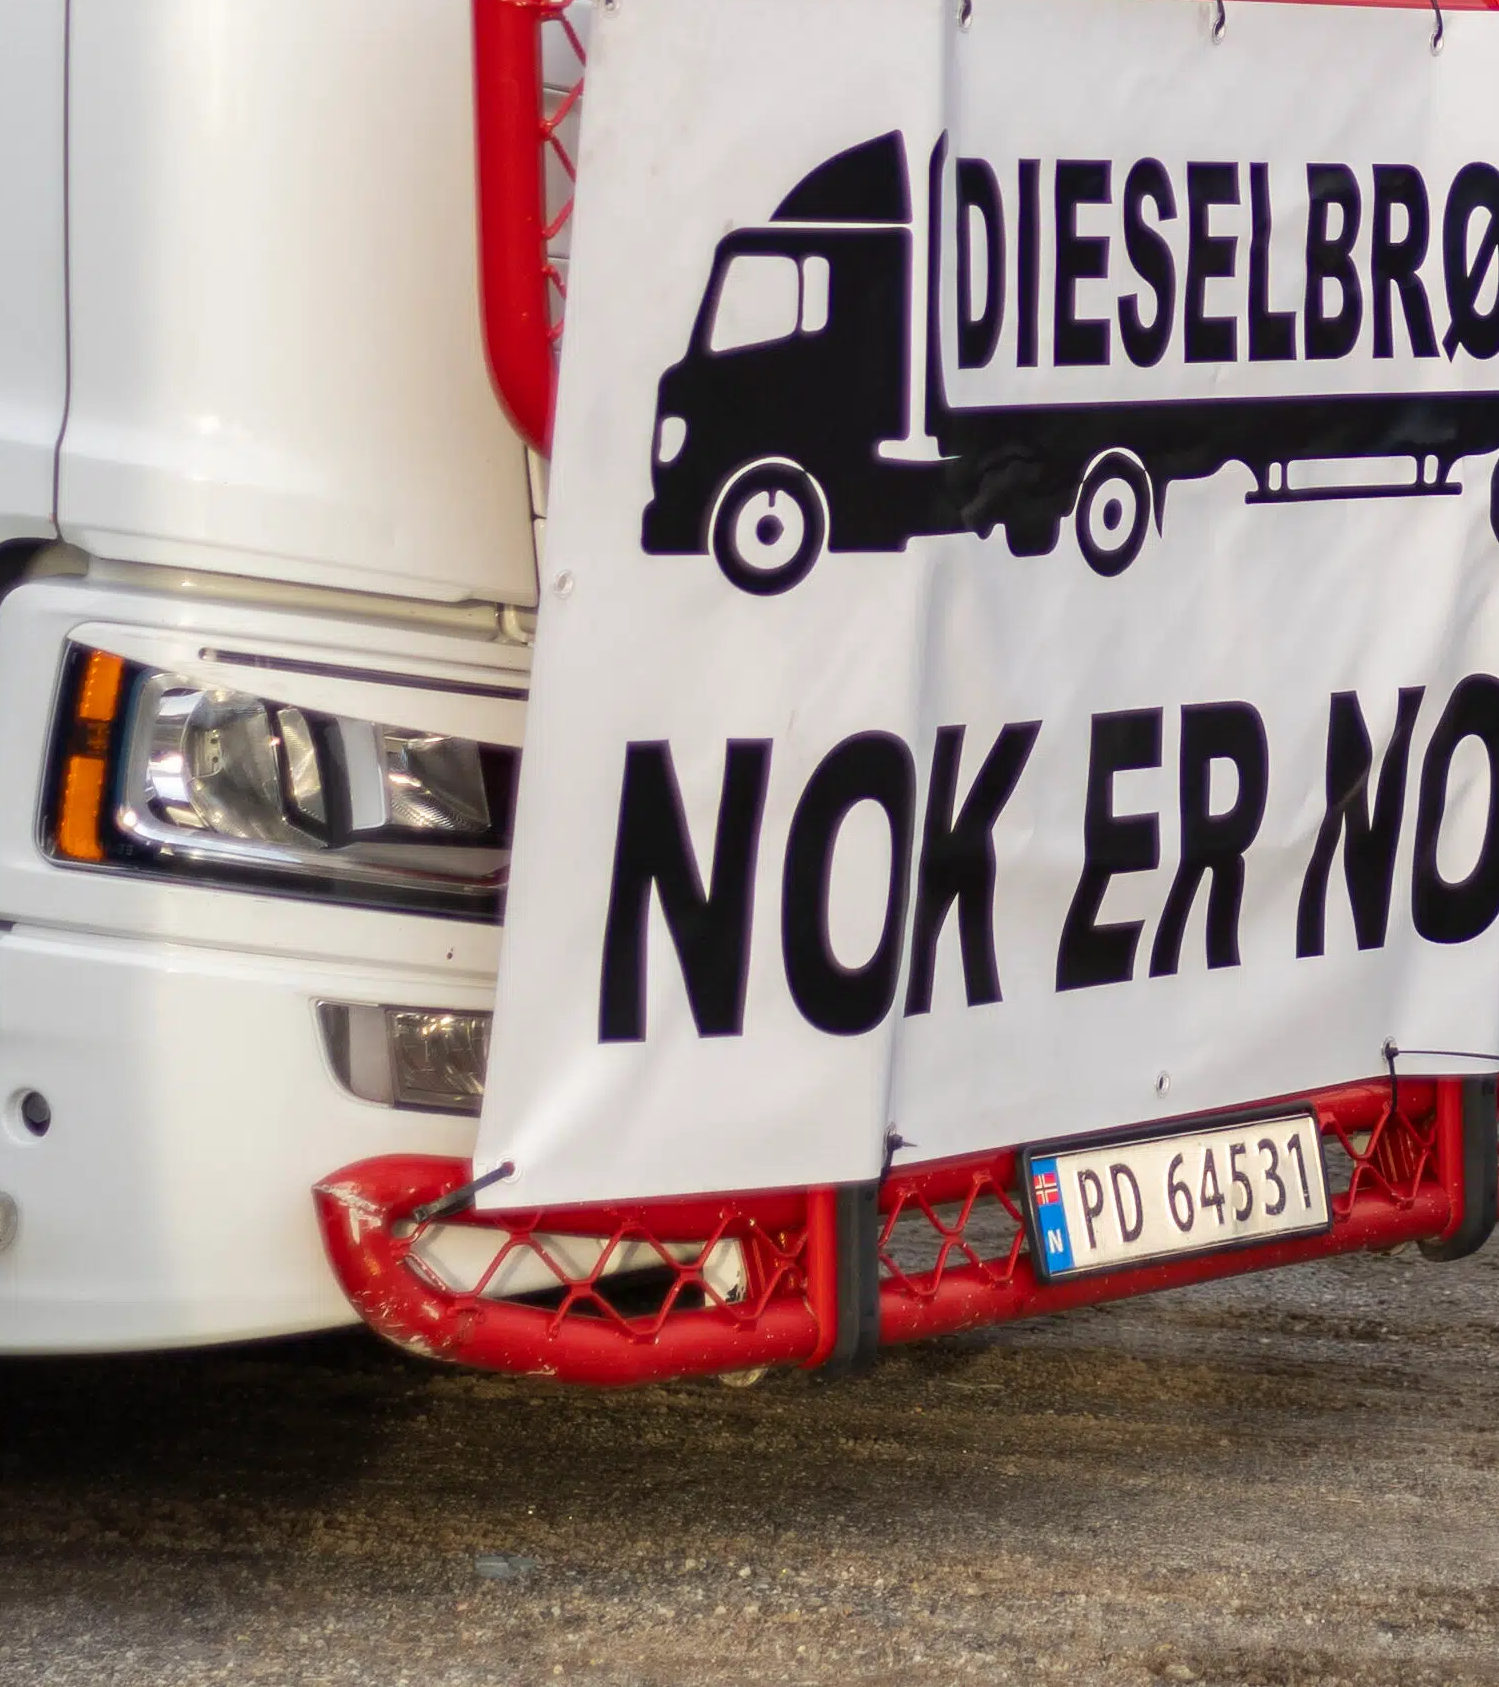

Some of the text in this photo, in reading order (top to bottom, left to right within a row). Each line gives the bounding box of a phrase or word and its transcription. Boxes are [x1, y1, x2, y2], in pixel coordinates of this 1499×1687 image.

[597, 719, 1044, 1044] NOK
[1055, 700, 1269, 993] ER
[1047, 1228, 1064, 1254] N
[1077, 1133, 1312, 1250] PD 64531
